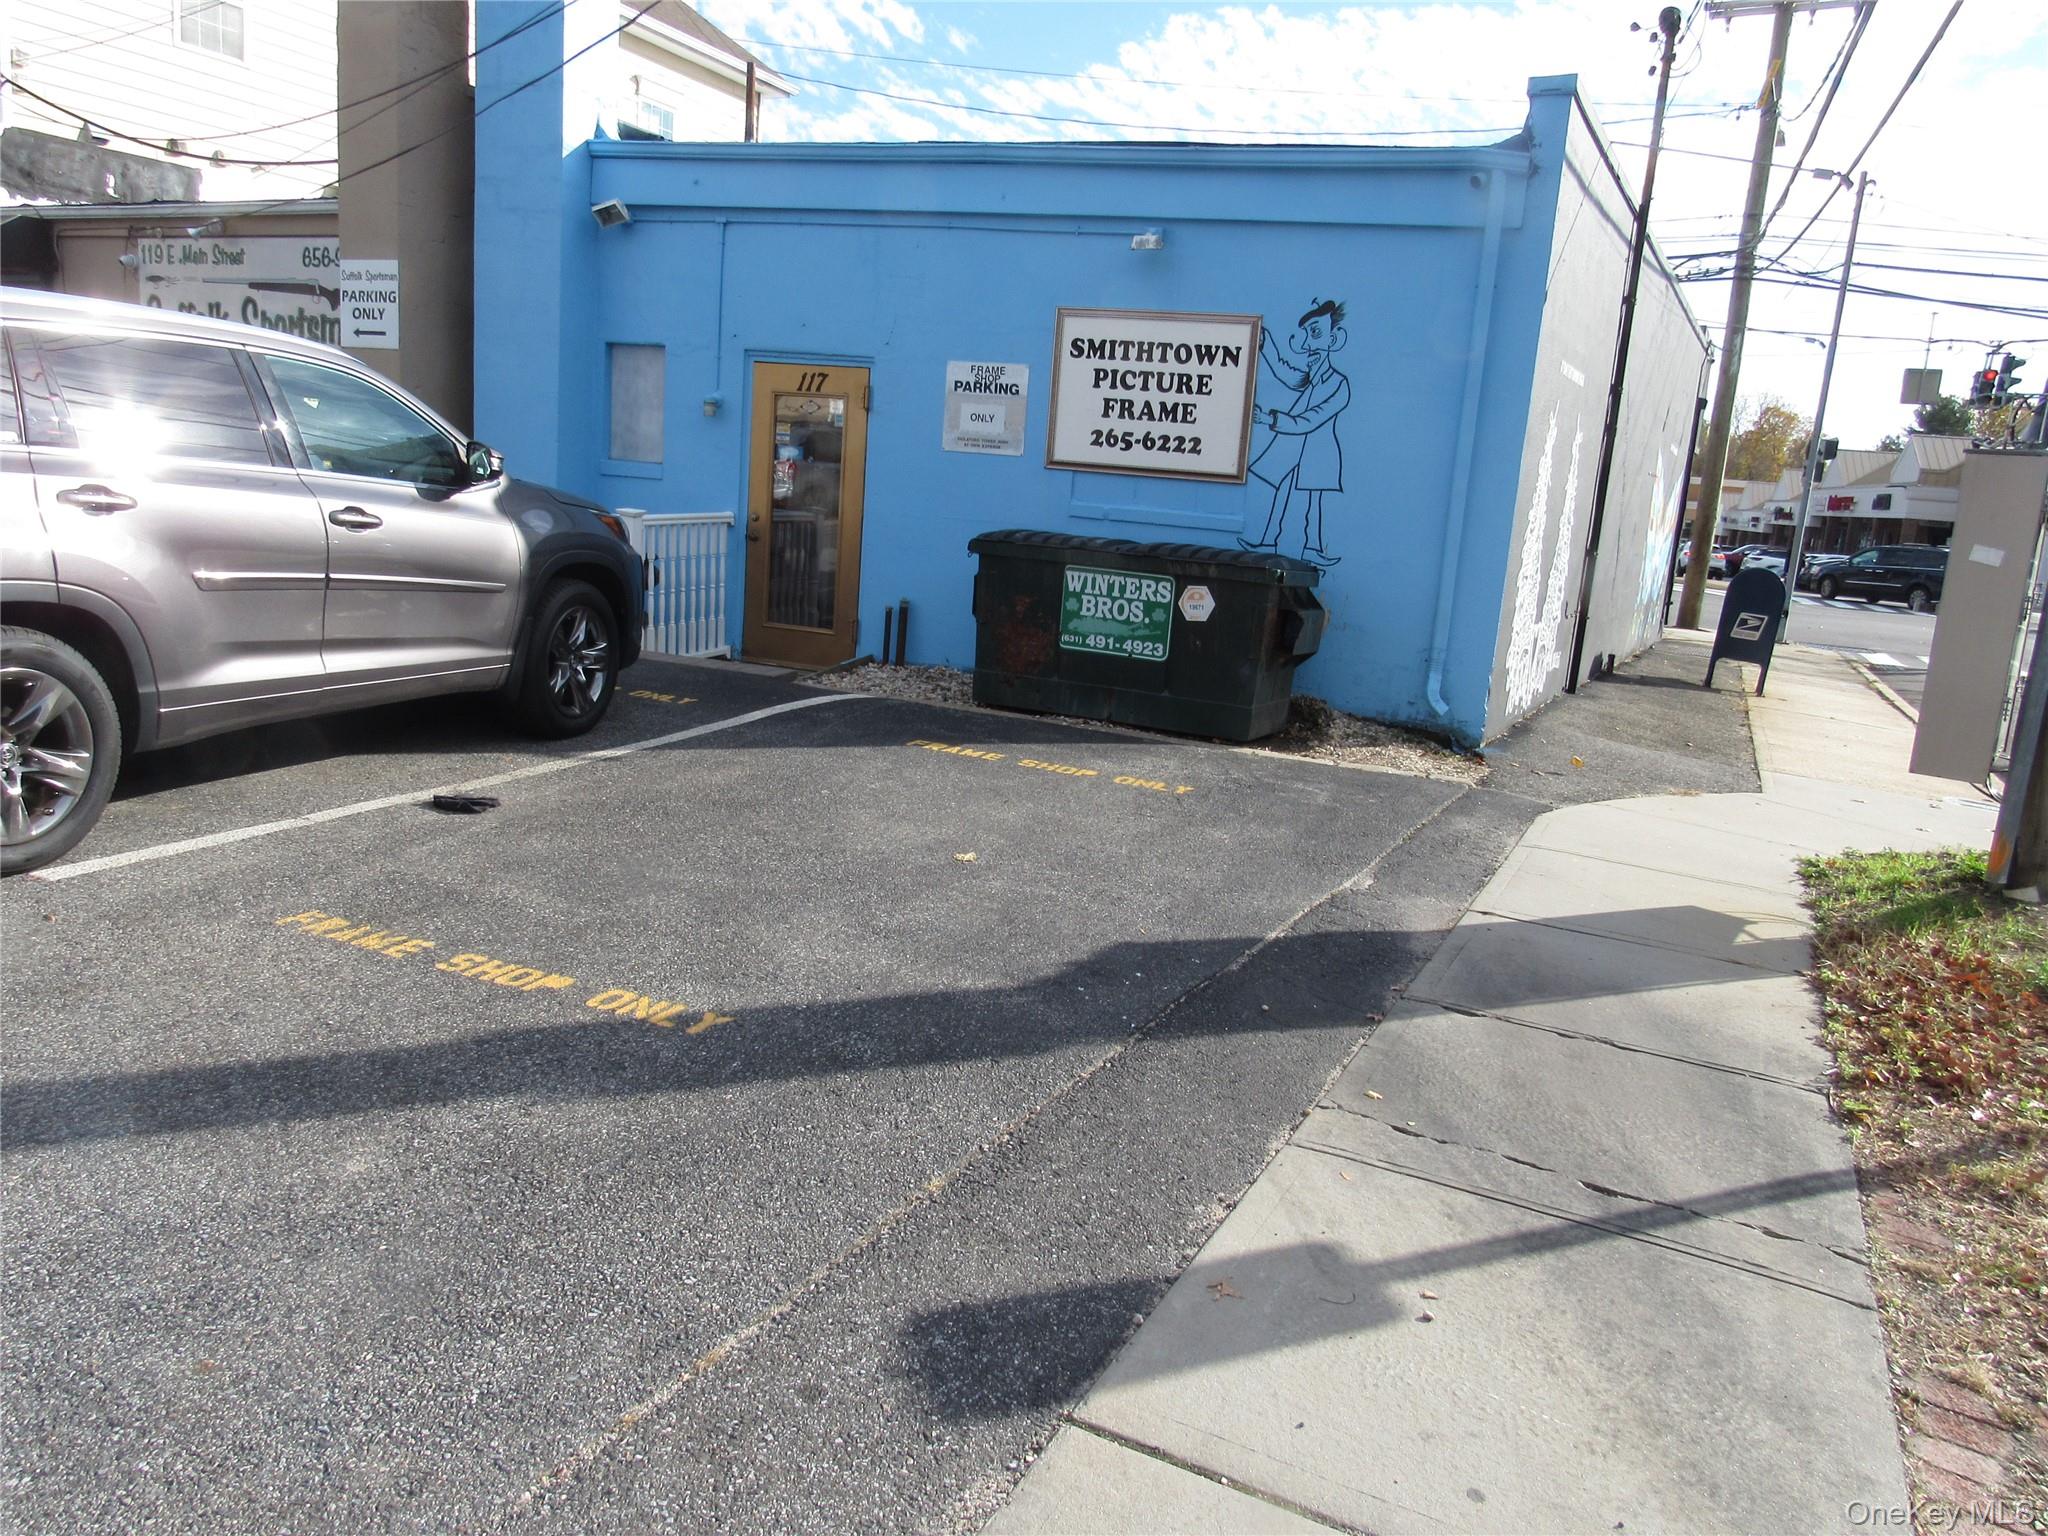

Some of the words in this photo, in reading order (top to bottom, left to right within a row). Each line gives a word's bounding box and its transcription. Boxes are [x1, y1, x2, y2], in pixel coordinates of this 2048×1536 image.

[141, 243, 164, 265] 119
[212, 243, 246, 265] Street
[341, 269, 363, 281] Suffolk
[365, 269, 398, 284] Sportsman
[341, 290, 397, 304] PARKING
[352, 307, 386, 320] ONLY
[1069, 337, 1243, 368] SMITHTOWN
[970, 365, 1006, 376] FRAME
[974, 374, 1001, 384] SHOP
[796, 371, 829, 393] 117
[953, 380, 1020, 396] PARKING
[1092, 368, 1213, 396] PICTURE
[969, 412, 995, 424] ONLY
[1101, 397, 1198, 425] FRAME
[1089, 428, 1202, 456] 265-6222
[1065, 570, 1172, 604] WINTERS
[1079, 594, 1150, 625] BROS.
[1061, 634, 1083, 645] (631)
[628, 690, 699, 704] ONLY
[905, 739, 1006, 761] FRAME
[1016, 758, 1098, 777] SHOP
[1112, 775, 1195, 794] ONLY
[274, 909, 436, 959] FRAME
[434, 952, 576, 993] SHOP
[586, 989, 736, 1035] ONLY
